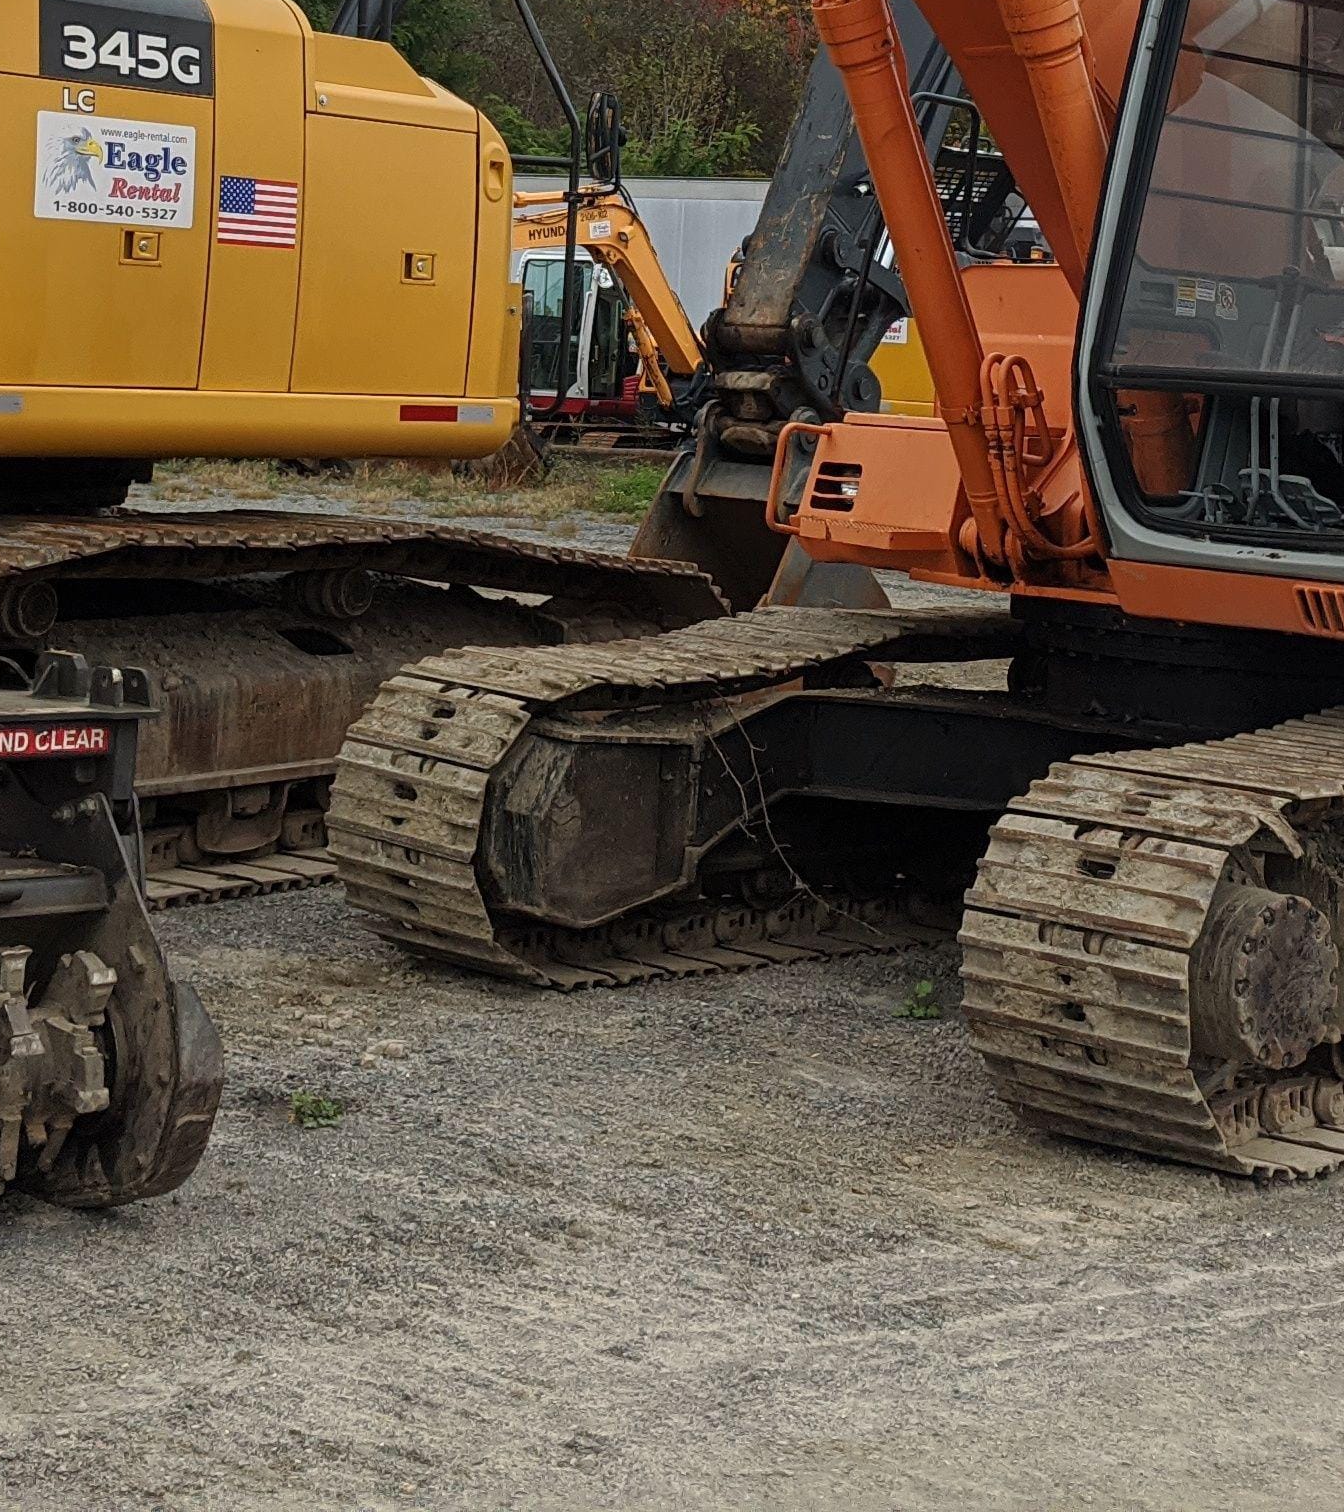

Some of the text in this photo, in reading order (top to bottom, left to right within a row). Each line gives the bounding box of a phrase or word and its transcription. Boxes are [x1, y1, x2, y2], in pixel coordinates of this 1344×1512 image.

[63, 25, 200, 84] 345G
[63, 89, 95, 112] LC
[101, 128, 188, 144] www.eagle-rental.com
[104, 141, 188, 182] Eagle
[108, 178, 182, 203] Rental
[53, 201, 177, 221] 1-800-540-5327
[529, 226, 568, 240] HYUND
[35, 729, 105, 751] CLEAR
